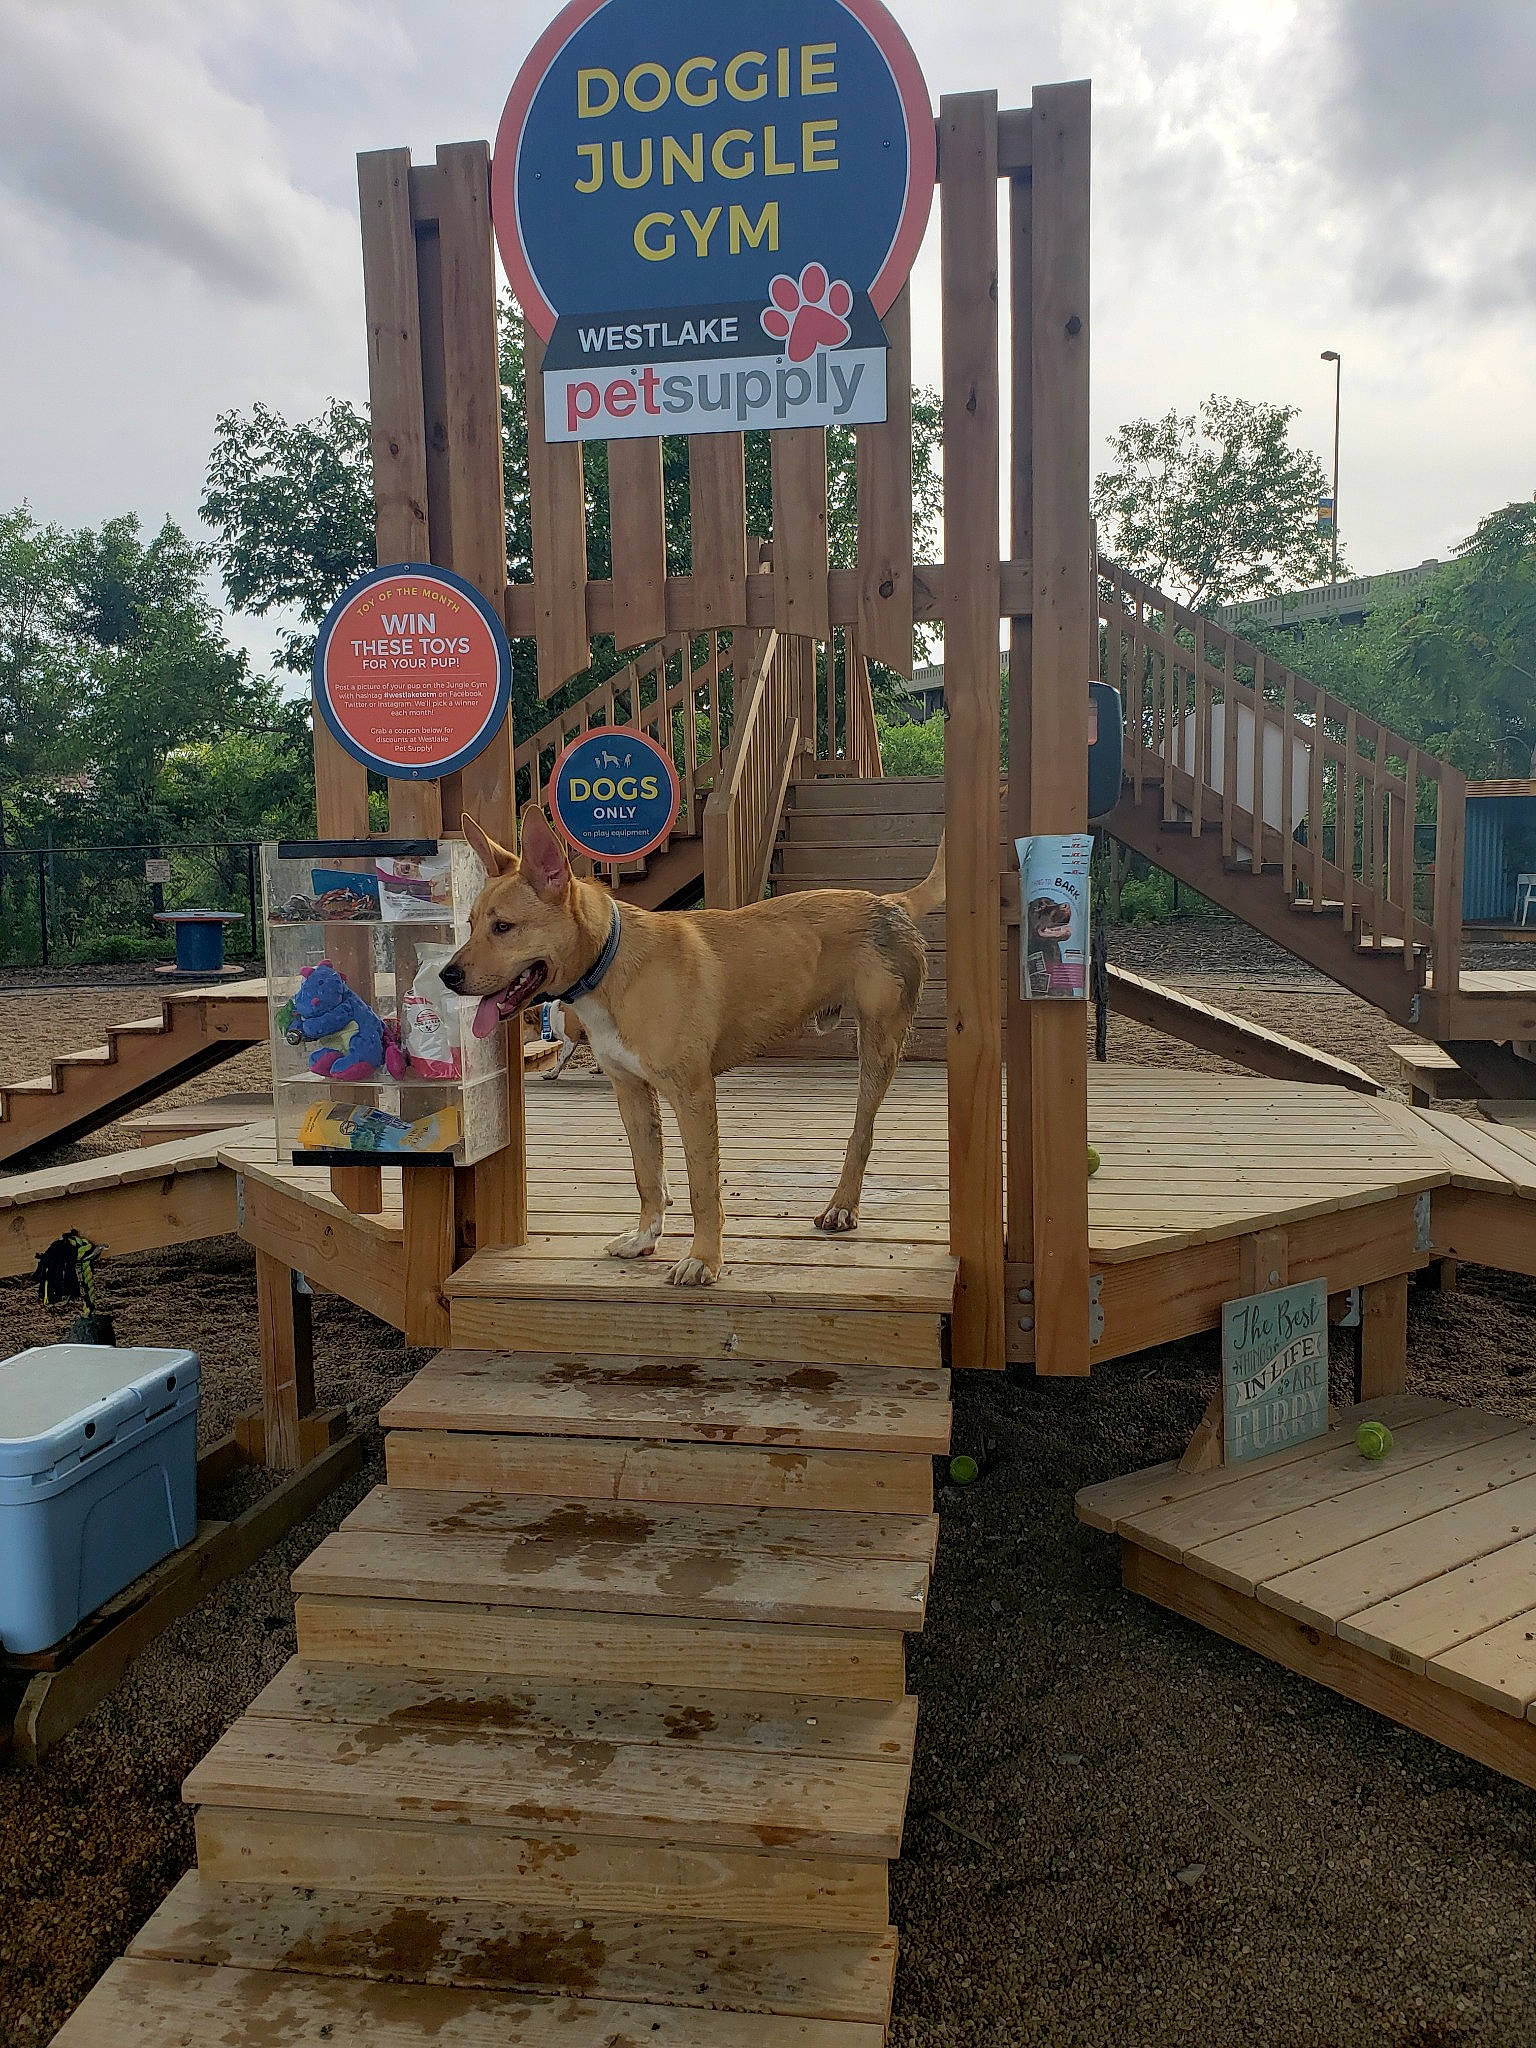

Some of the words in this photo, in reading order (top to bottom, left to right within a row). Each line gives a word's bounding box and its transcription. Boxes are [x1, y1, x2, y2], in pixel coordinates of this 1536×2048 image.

[576, 42, 838, 119] DOGGIE
[574, 119, 839, 194] JUNGLE
[634, 201, 780, 261] GYM
[578, 318, 738, 352] WESTLAKE
[357, 598, 375, 616] TOY
[379, 590, 392, 601] OF
[396, 587, 418, 596] THE
[422, 588, 460, 613] MONTH
[381, 613, 436, 635] WIN
[351, 638, 414, 656] THESE
[419, 637, 470, 655] TOYS
[362, 659, 387, 669] FOR
[391, 658, 426, 669] YOUR
[431, 657, 460, 668] PUP!
[335, 683, 350, 691] Post
[357, 683, 380, 691] picture
[390, 683, 405, 691] your
[446, 681, 470, 690] Jungle
[471, 681, 488, 690] Gym
[338, 692, 354, 700] with
[355, 692, 382, 700] hashtag
[390, 709, 408, 717] each
[408, 709, 434, 717] month!
[414, 699, 431, 707] We'll
[432, 699, 448, 708] pick
[454, 699, 479, 707] winner
[370, 727, 387, 735] Grab
[394, 727, 421, 735] coupon
[421, 726, 443, 734] below
[443, 726, 454, 734] for
[417, 735, 449, 743] Westlake
[407, 744, 433, 753] Supply!
[569, 776, 659, 802] DOGS
[593, 806, 637, 819] ONLY
[582, 830, 592, 838] on
[593, 829, 610, 838] play
[611, 828, 650, 838] equipment
[1054, 877, 1081, 900] BARK
[1232, 1304, 1273, 1350] The
[1278, 1298, 1320, 1339] Best
[1239, 1340, 1275, 1376] THINGS
[1244, 1371, 1266, 1400] IN
[1271, 1337, 1315, 1382] LIFE
[1292, 1361, 1320, 1394] ARE
[1233, 1390, 1321, 1457] FURRY
